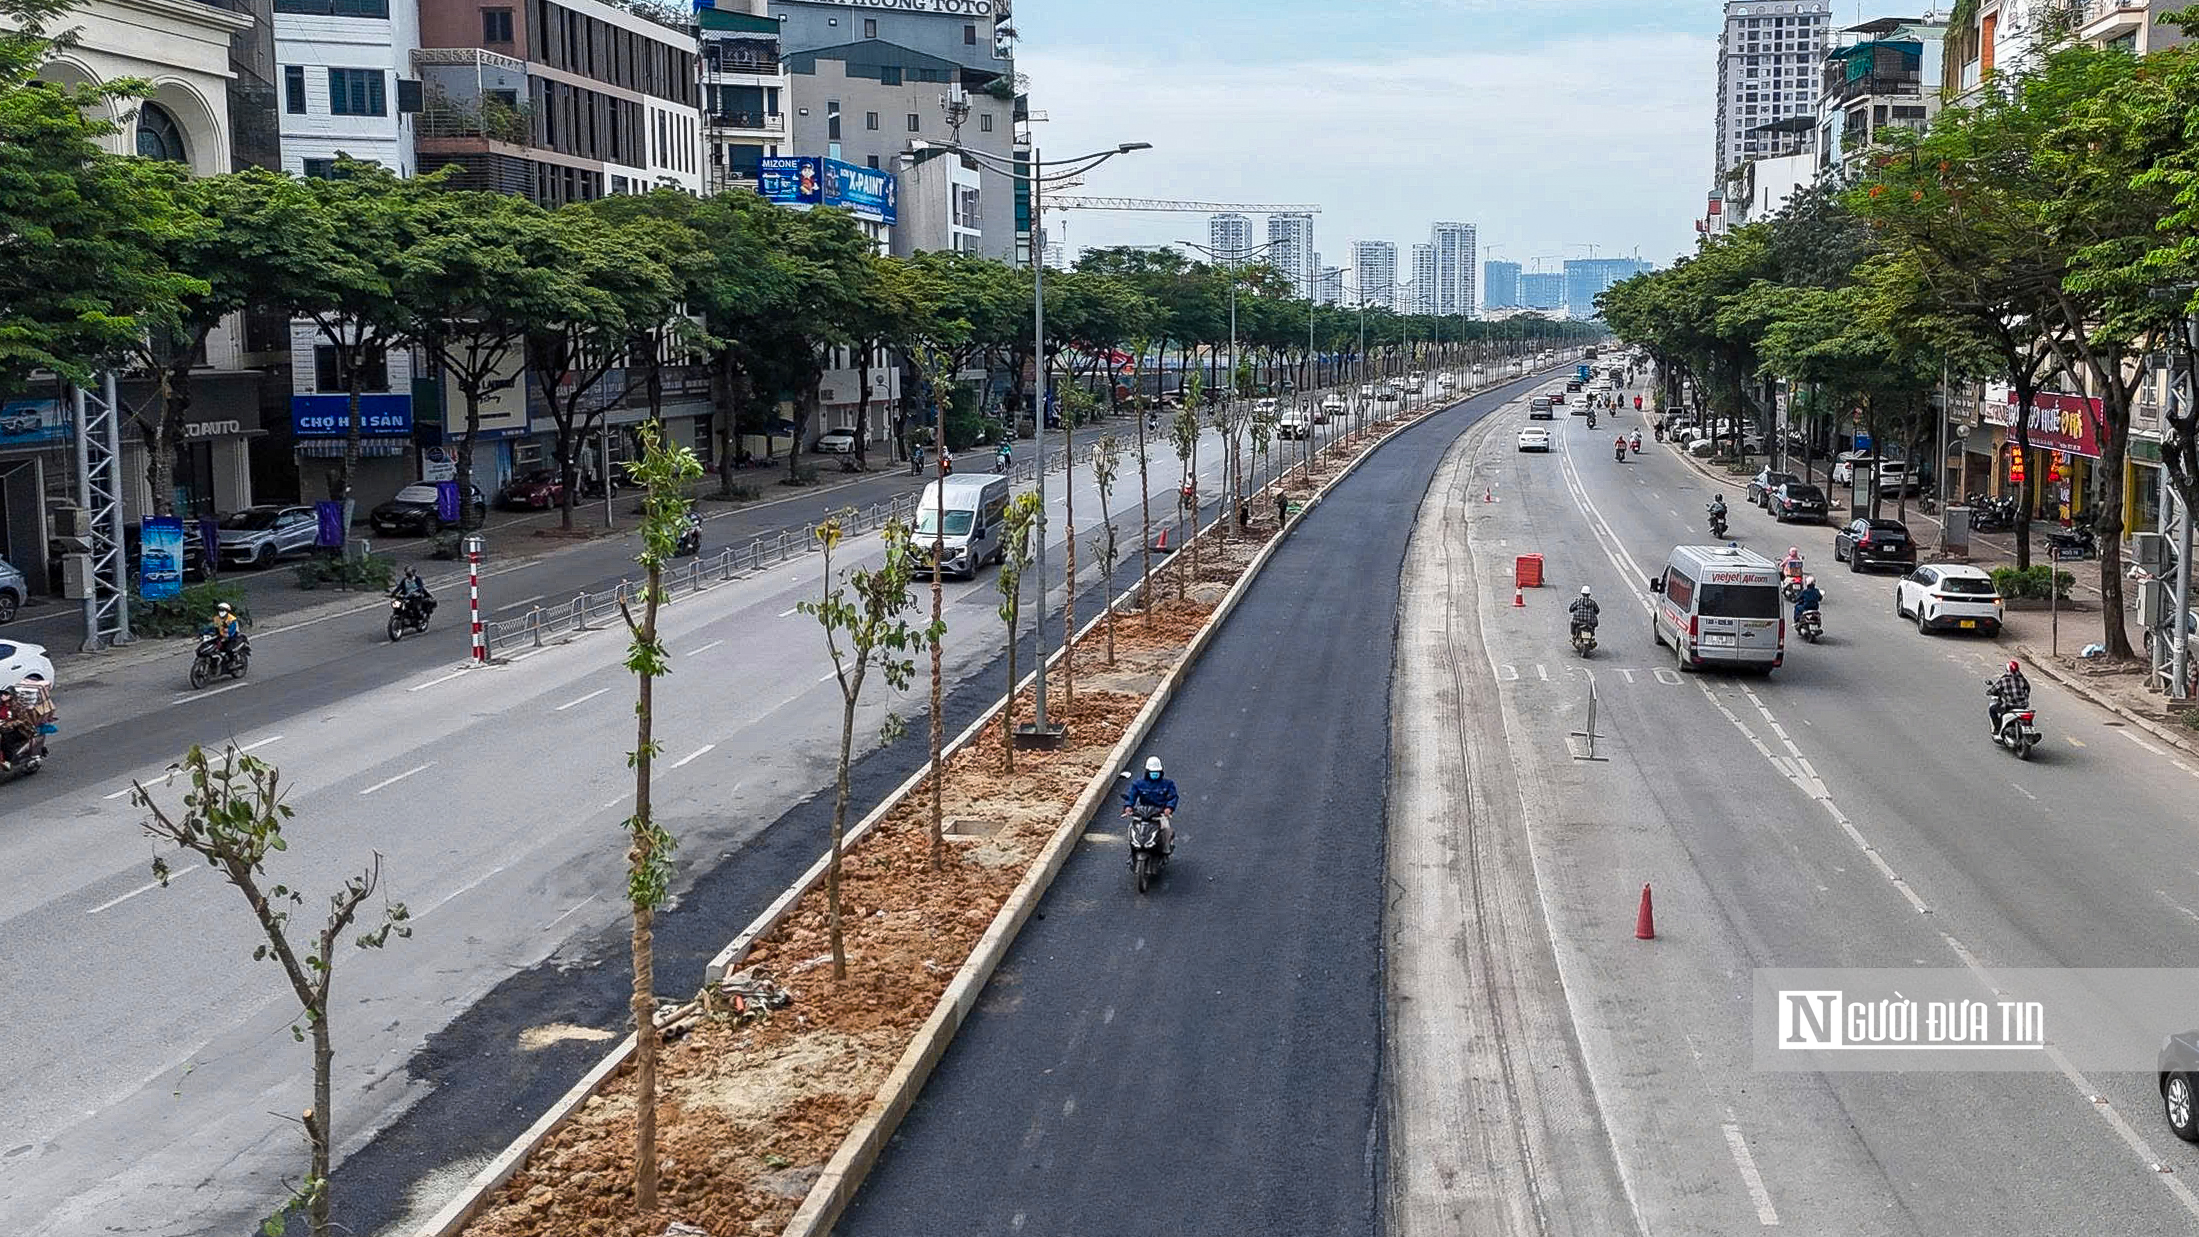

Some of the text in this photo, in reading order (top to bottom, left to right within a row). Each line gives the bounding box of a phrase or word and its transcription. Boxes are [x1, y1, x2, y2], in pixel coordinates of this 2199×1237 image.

[932, 1, 991, 15] TOTO
[761, 159, 798, 169] MIZONE
[848, 171, 884, 197] X-PAINT
[338, 416, 367, 428] HI
